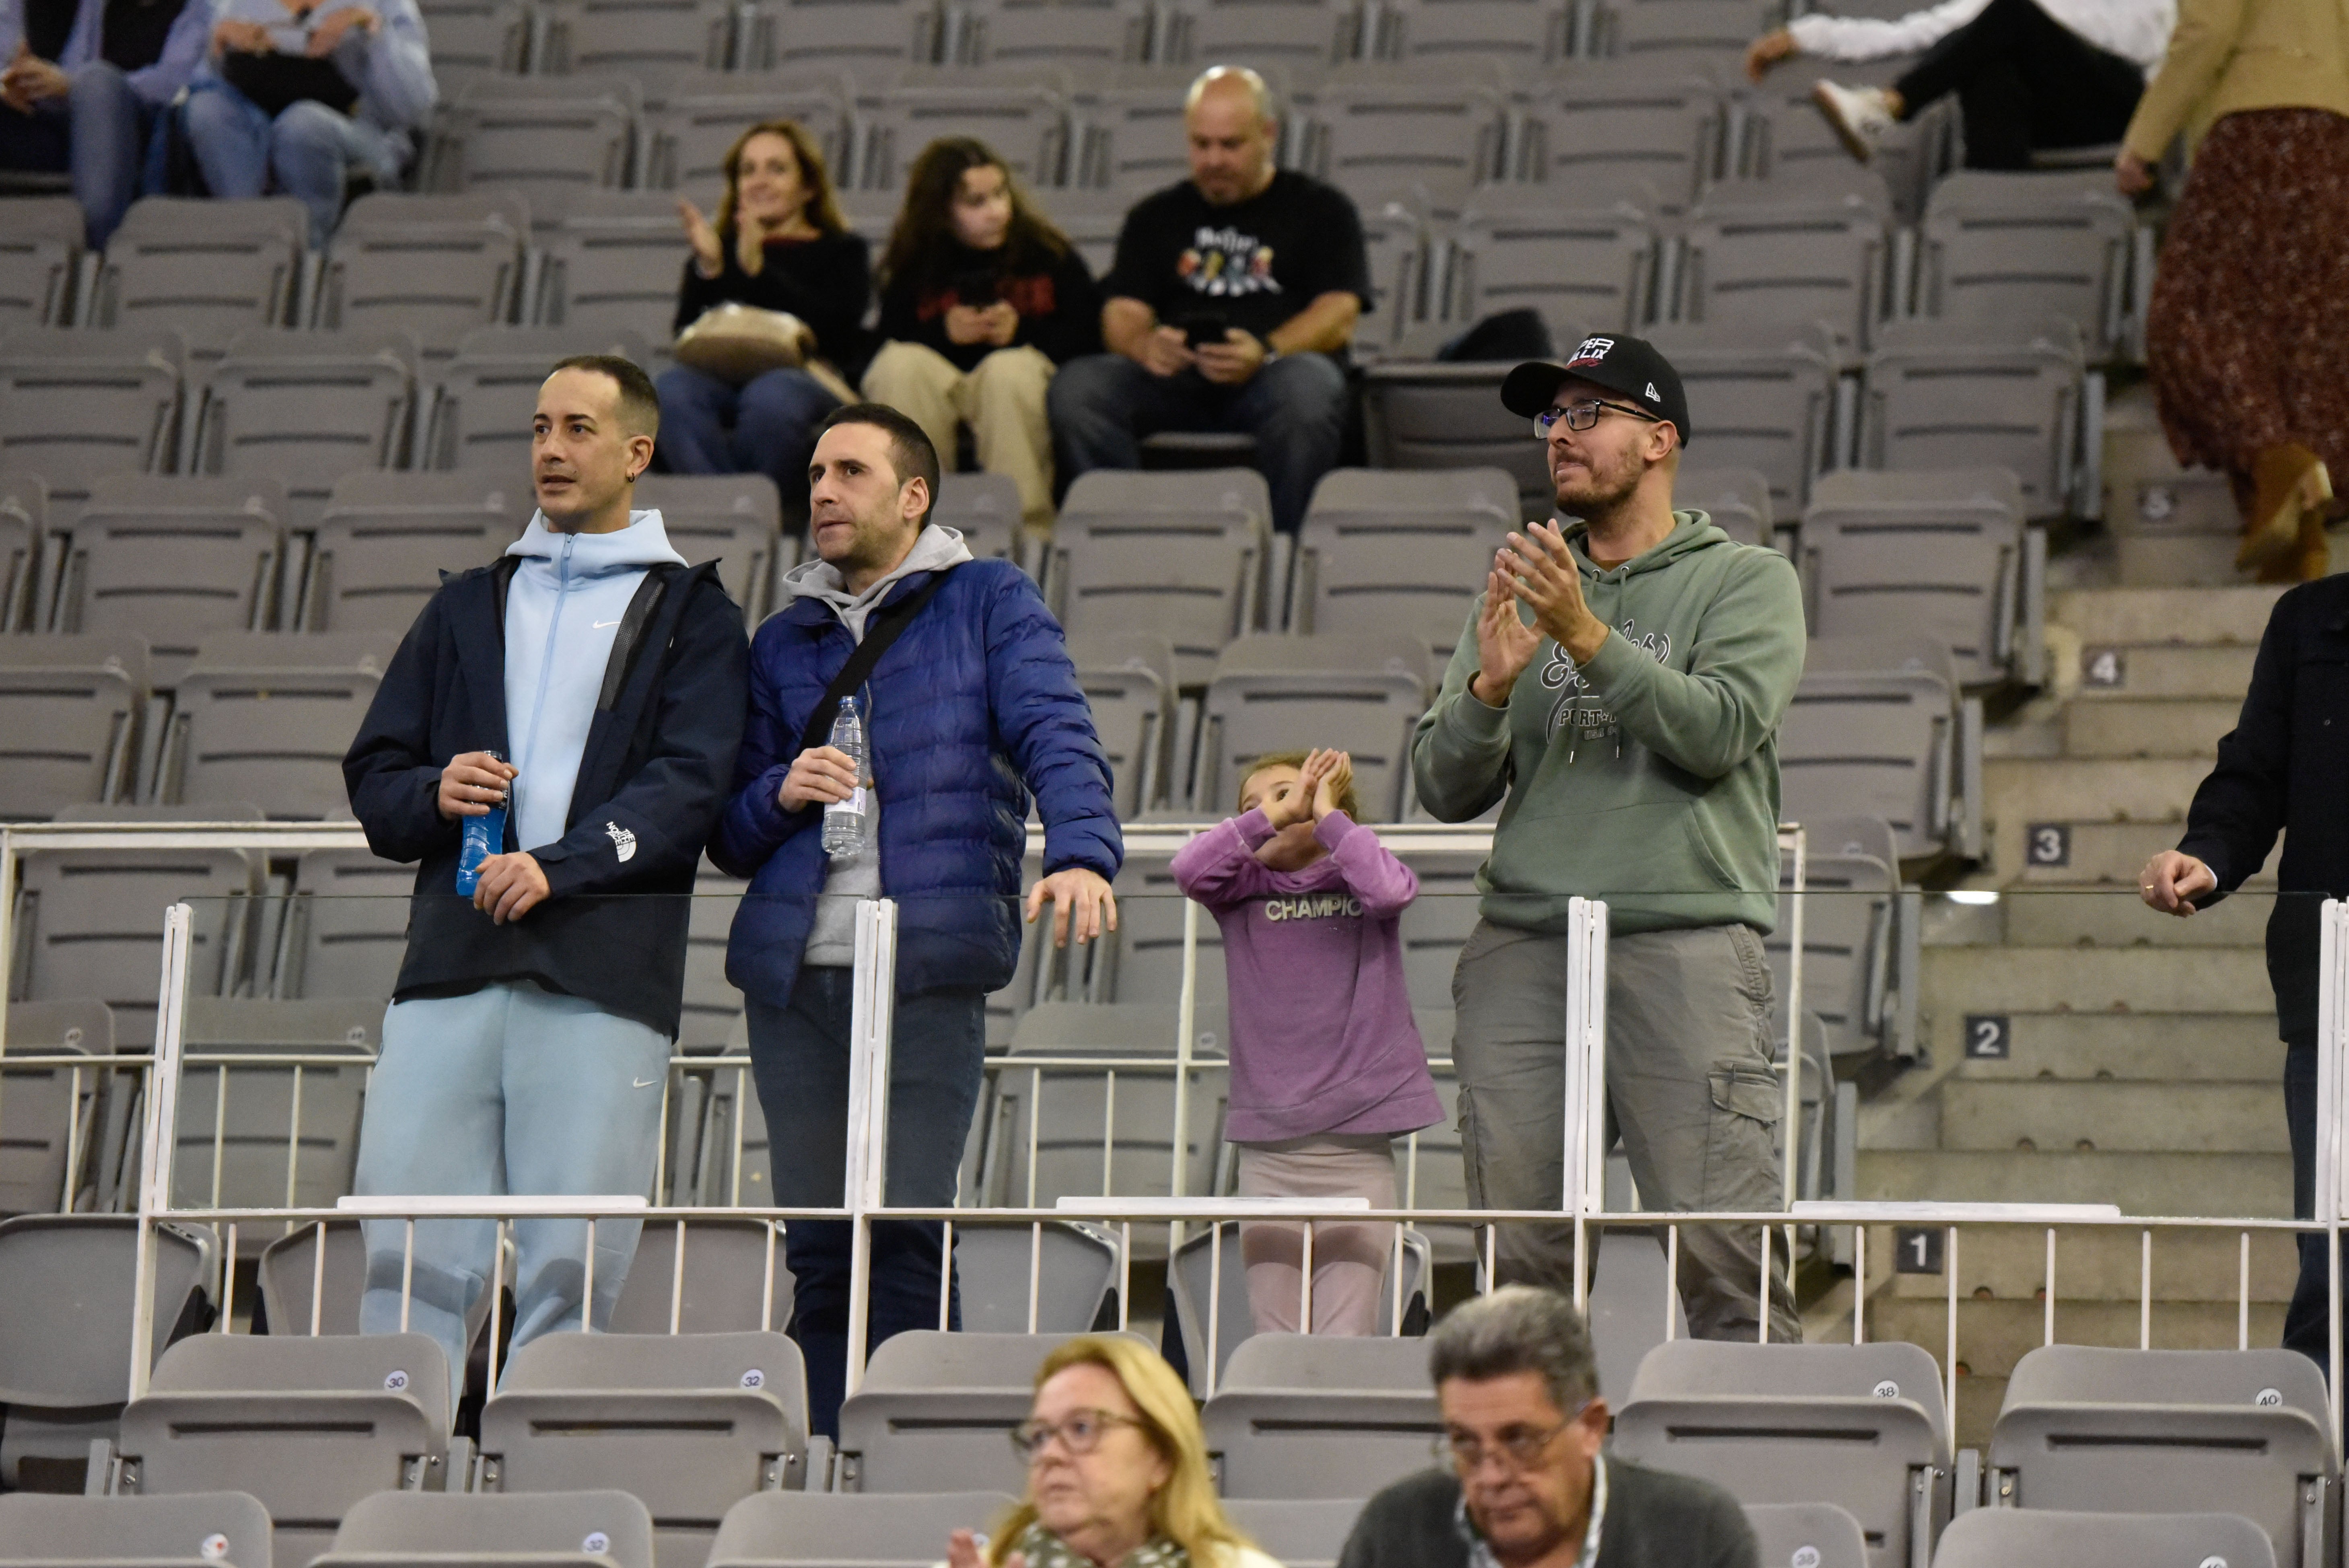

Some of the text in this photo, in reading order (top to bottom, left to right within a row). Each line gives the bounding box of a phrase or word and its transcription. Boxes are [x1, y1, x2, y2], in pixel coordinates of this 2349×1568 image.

[2093, 652, 2116, 682] 4
[1584, 728, 1605, 740] USA
[605, 831, 623, 846] FACE
[606, 821, 630, 844] NORTH
[625, 829, 636, 842] THE
[2036, 828, 2062, 862] 3
[1976, 1021, 2001, 1054] 2
[1910, 1234, 1927, 1267] 1
[387, 1377, 405, 1389] 30
[743, 1376, 760, 1387] 32
[1878, 1386, 1895, 1397] 38
[2260, 1394, 2277, 1406] 40
